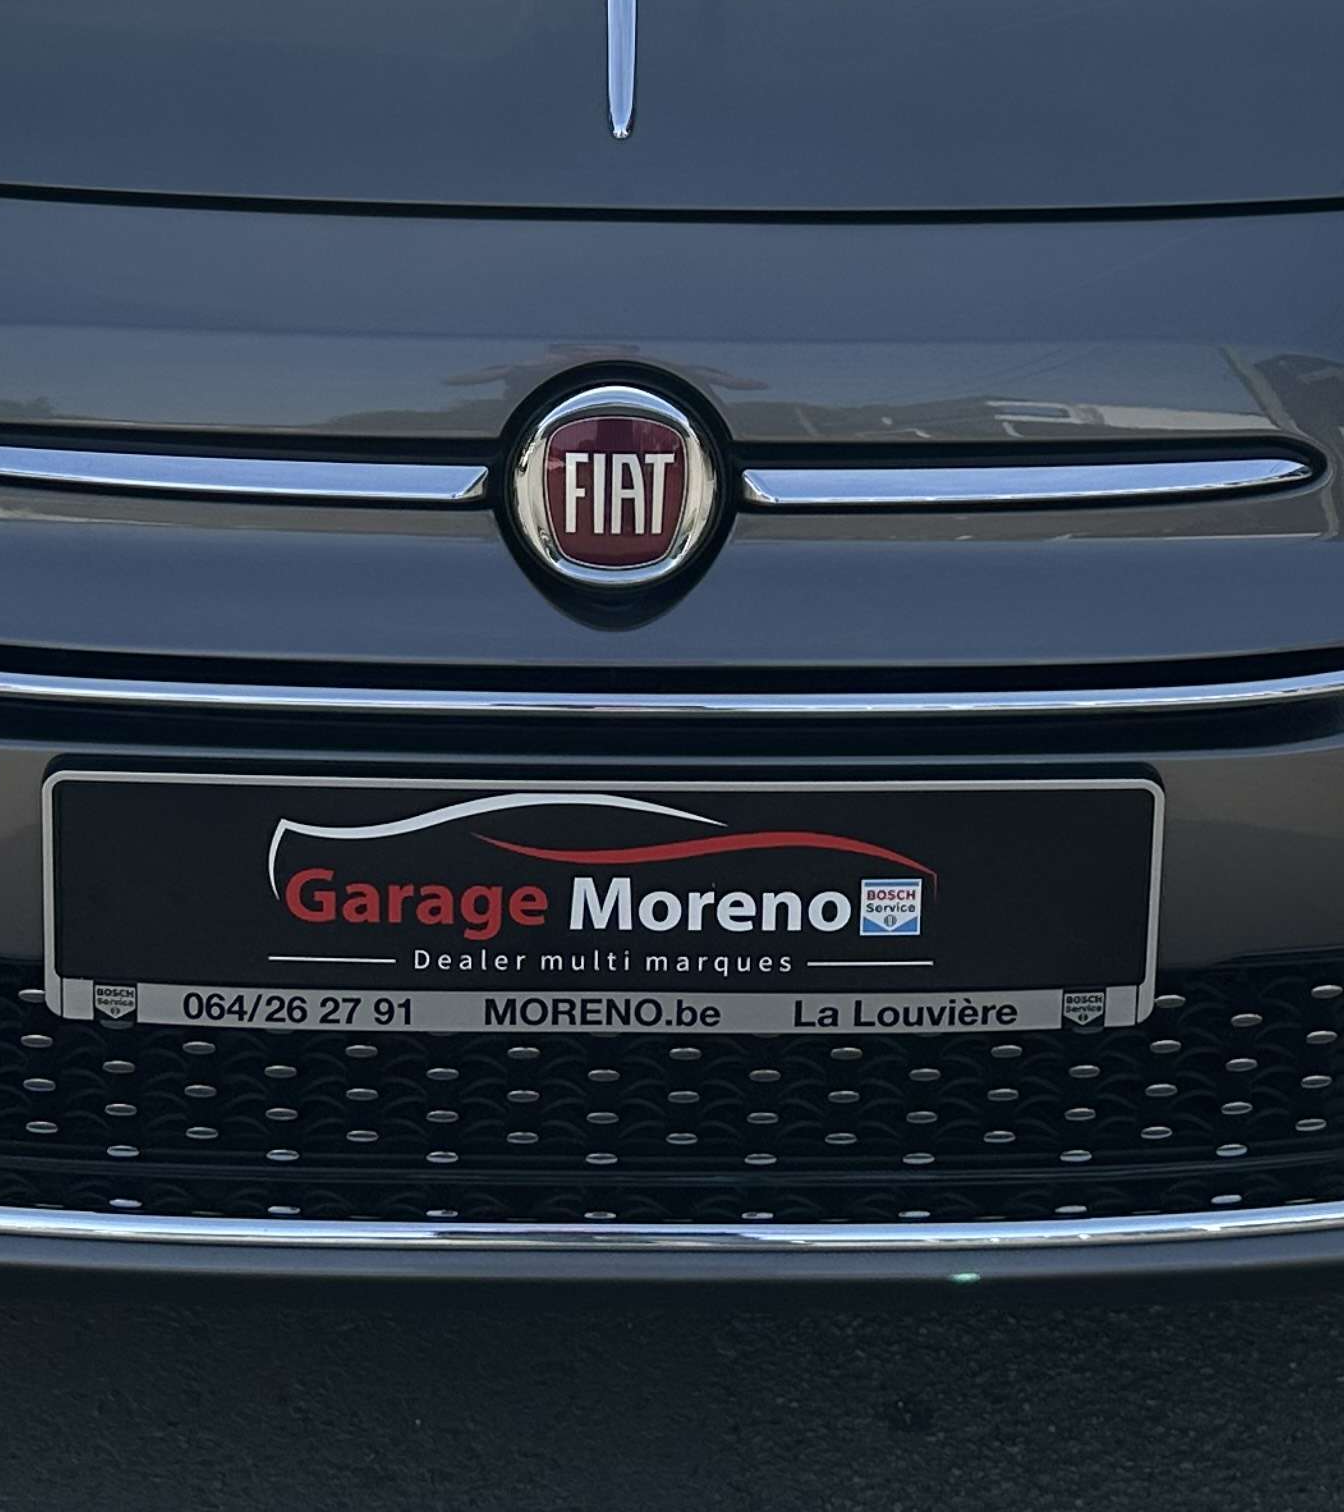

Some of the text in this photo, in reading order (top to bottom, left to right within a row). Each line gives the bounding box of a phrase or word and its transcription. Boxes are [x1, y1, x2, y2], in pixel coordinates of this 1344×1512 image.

[565, 451, 675, 535] FIAT
[284, 867, 852, 941] Garage Moreno
[866, 902, 916, 913] Service
[867, 890, 916, 901] BOSCH
[413, 949, 792, 977] Dealer multi marques
[182, 992, 1018, 1028] 064/26 27 91 MORENO.be La Louvière
